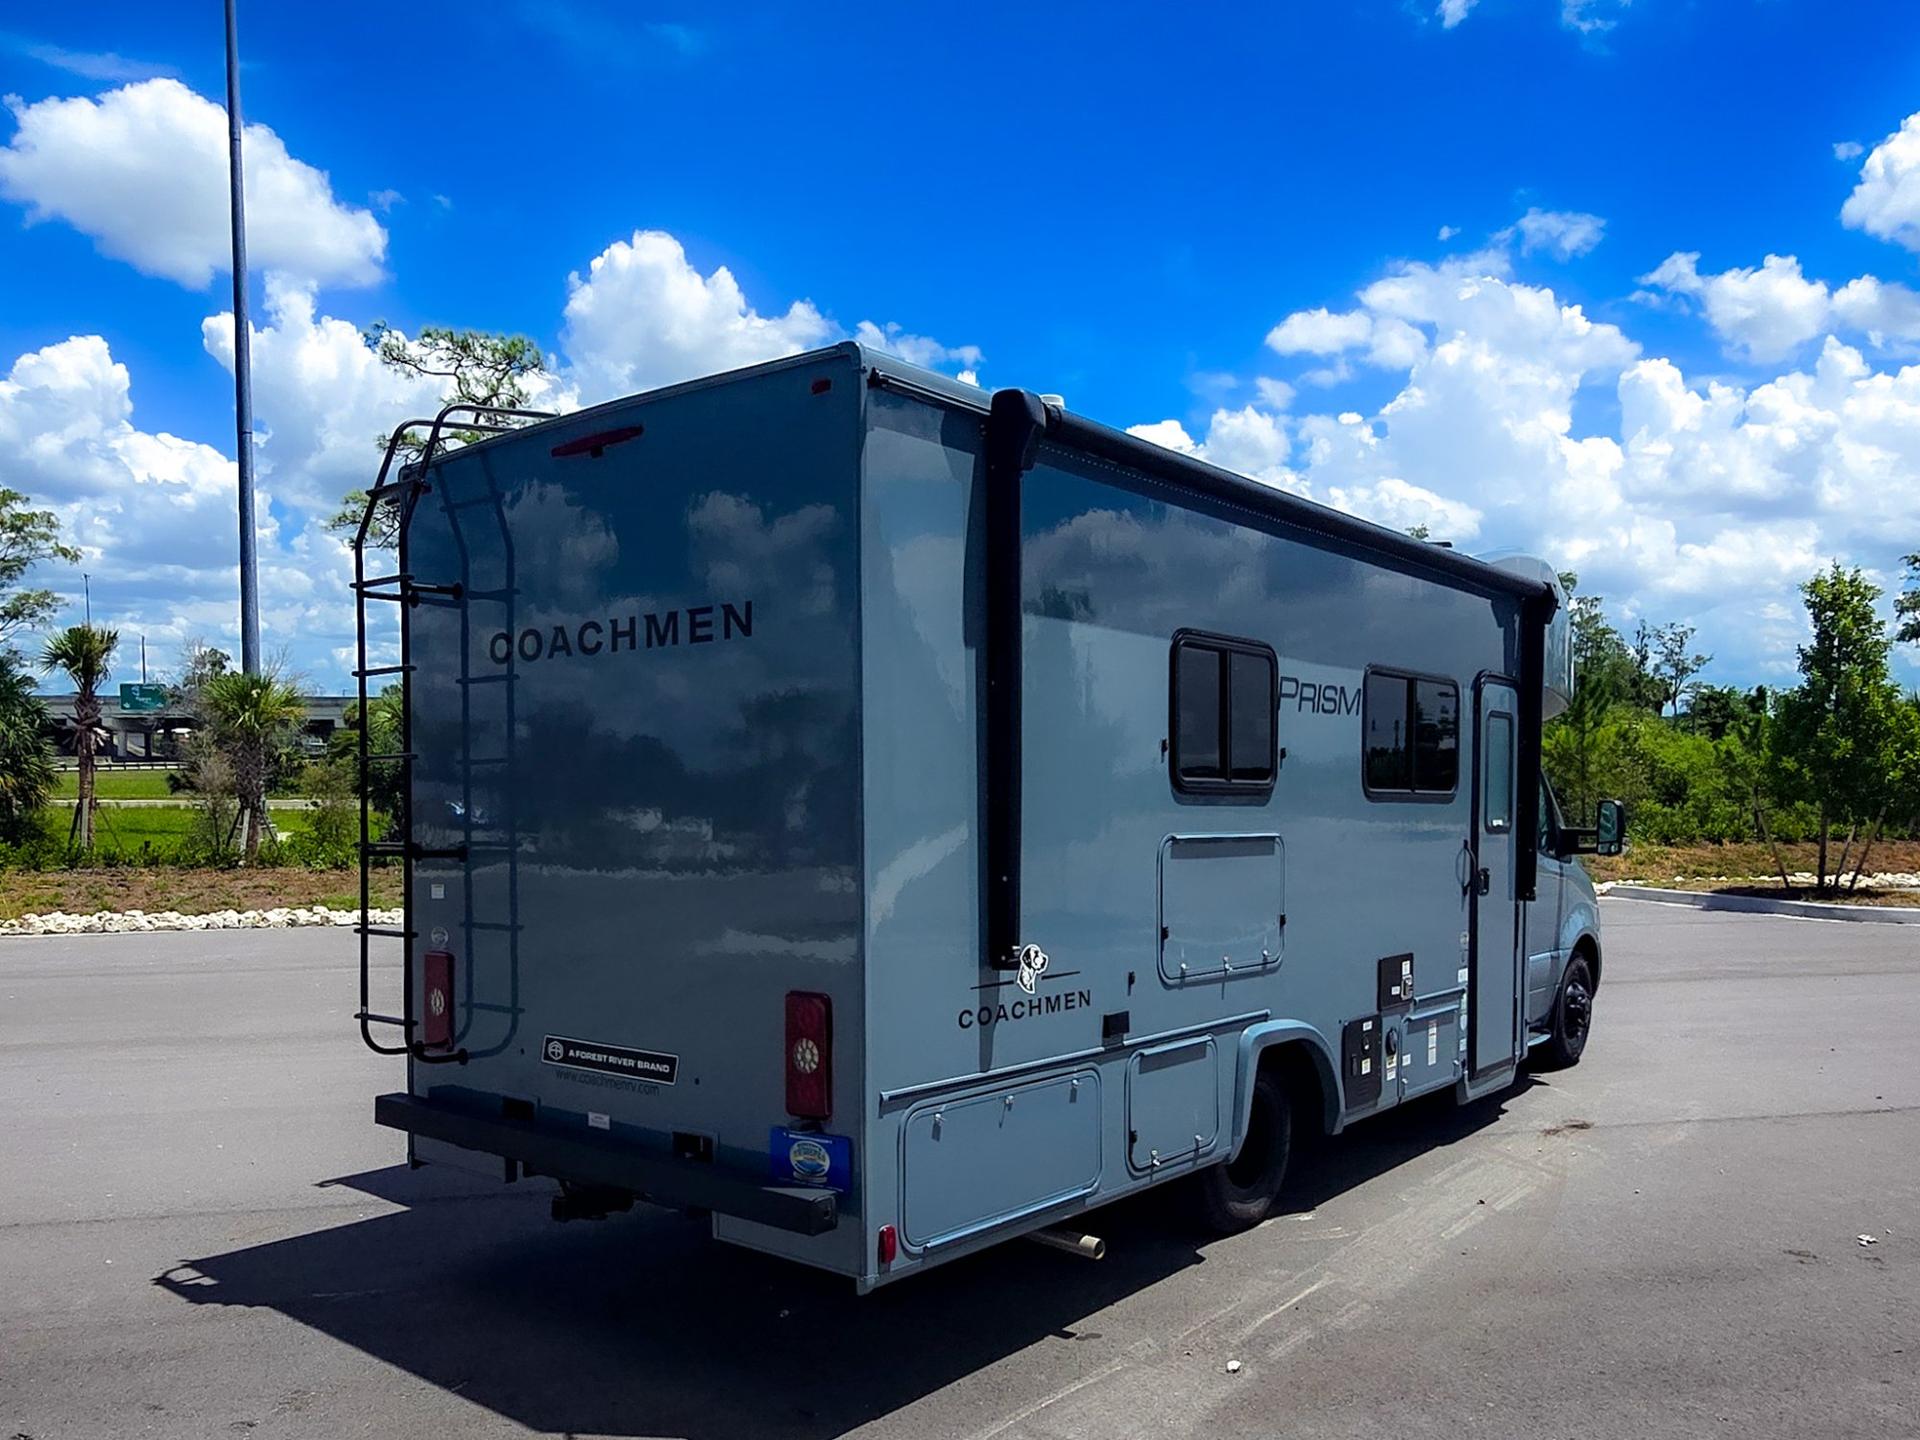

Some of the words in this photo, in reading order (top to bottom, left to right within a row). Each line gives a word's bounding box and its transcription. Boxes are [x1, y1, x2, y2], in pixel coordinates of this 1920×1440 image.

[489, 600, 753, 665] COACHMEN
[1278, 676, 1362, 716] PRISM
[958, 989, 1091, 1029] COACHMEN
[568, 1049, 575, 1057] A
[575, 1050, 608, 1063] FOREST
[637, 1060, 670, 1073] BRAND
[555, 1068, 661, 1097] www.coachmenrv.com
